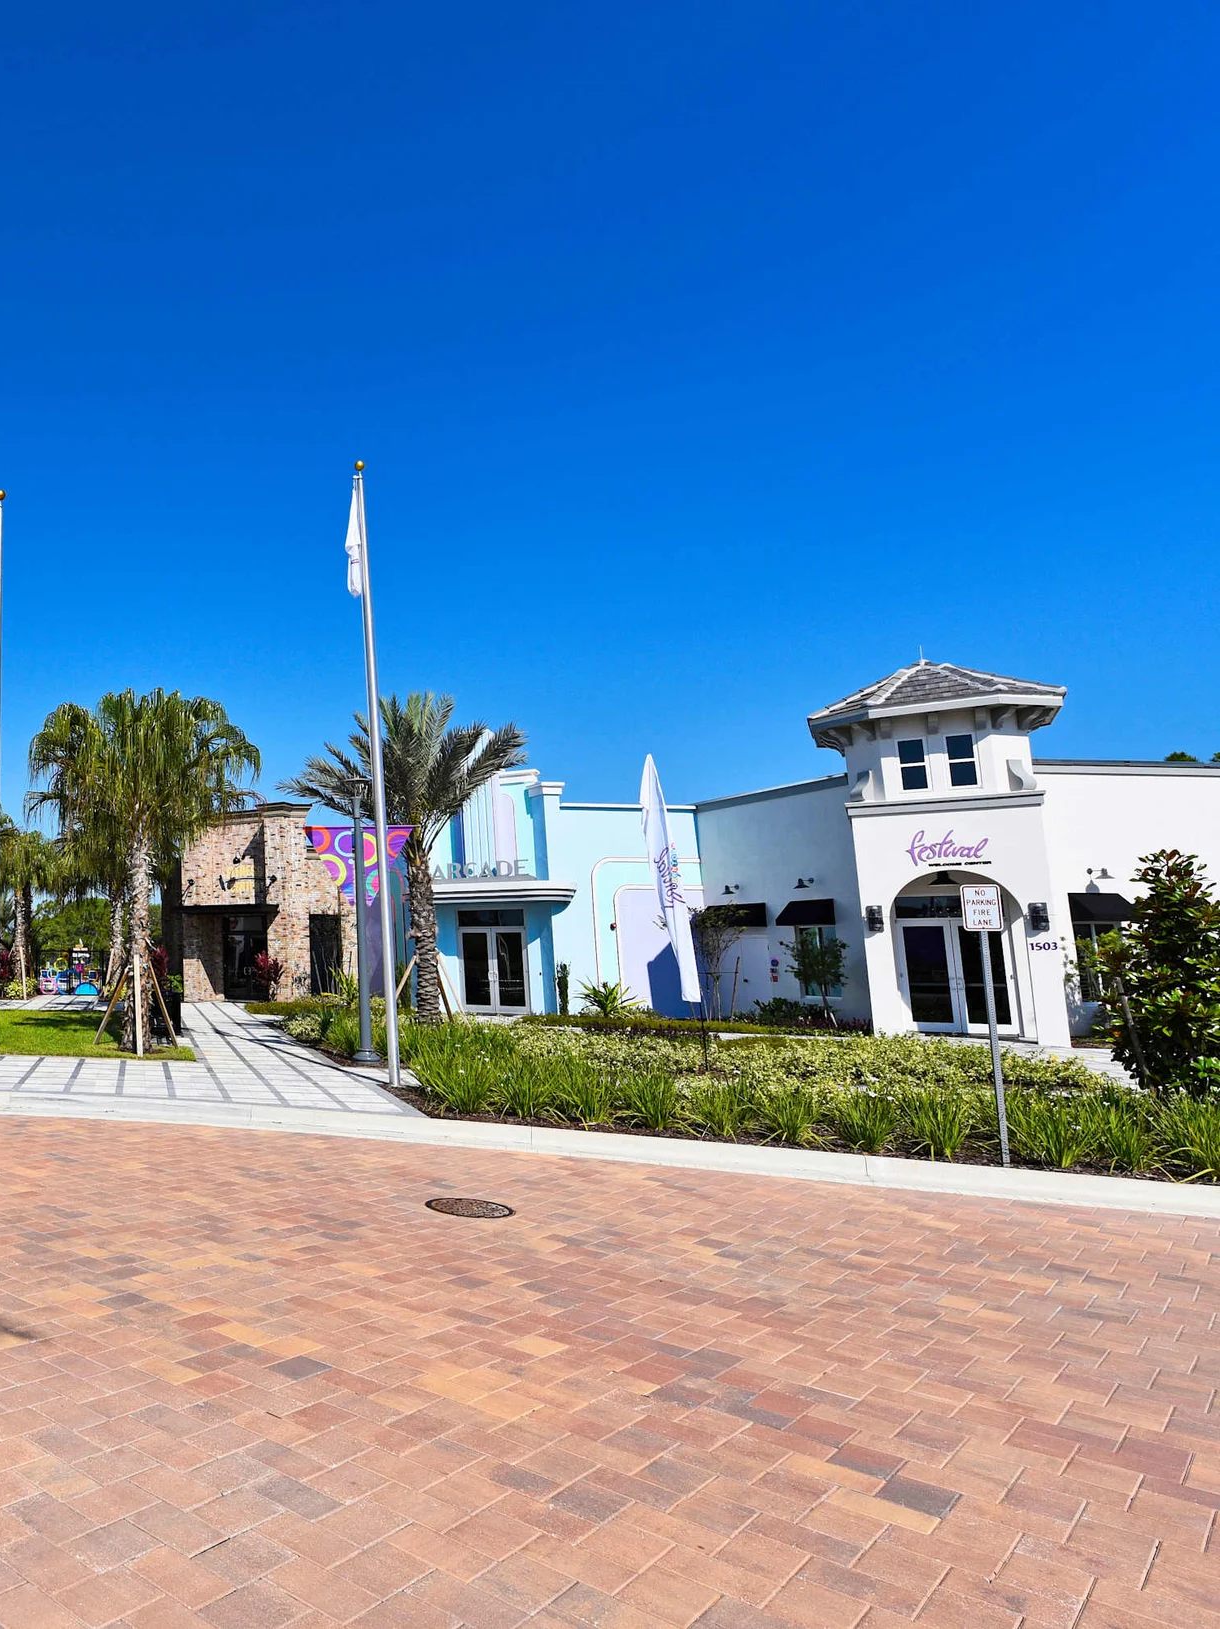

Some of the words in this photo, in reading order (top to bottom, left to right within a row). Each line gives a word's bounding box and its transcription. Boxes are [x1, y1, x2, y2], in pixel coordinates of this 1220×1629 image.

[905, 829, 989, 867] festival
[433, 859, 529, 880] ARCADE
[974, 889, 986, 897] NO
[1029, 942, 1058, 951] 1503
